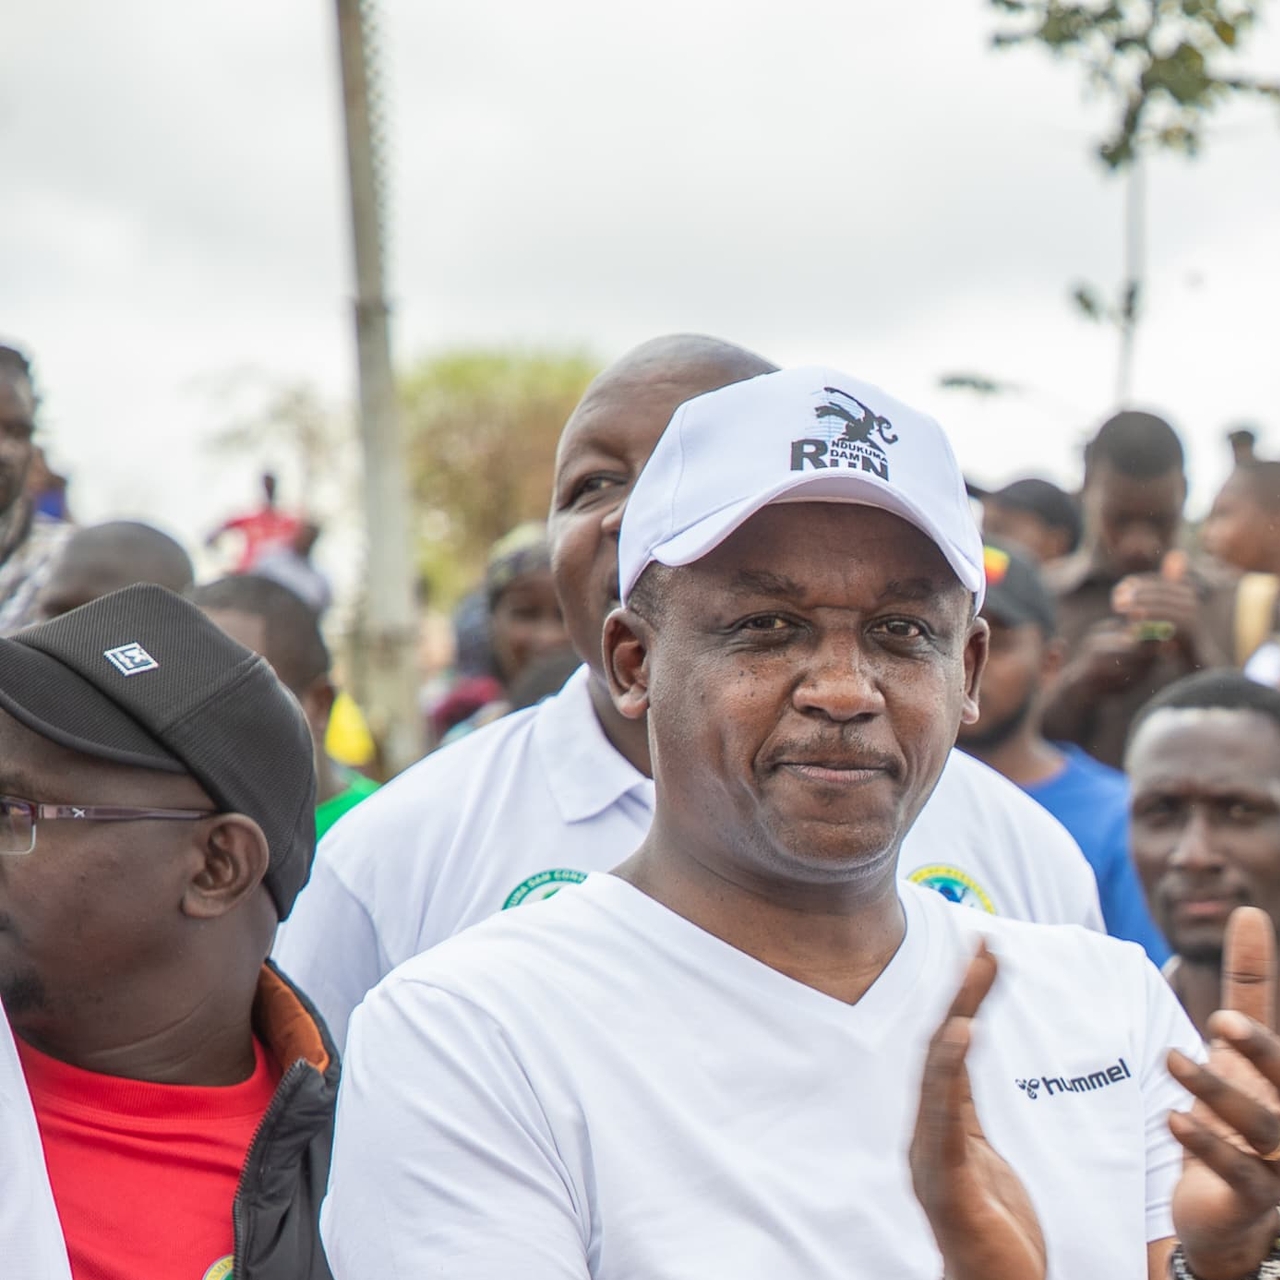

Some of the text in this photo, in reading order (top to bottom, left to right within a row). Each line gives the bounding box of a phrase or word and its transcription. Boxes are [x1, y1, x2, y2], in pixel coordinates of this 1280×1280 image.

[830, 449, 860, 461] DAM
[831, 440, 888, 463] NDUKUMA
[1041, 1058, 1131, 1095] hummel
